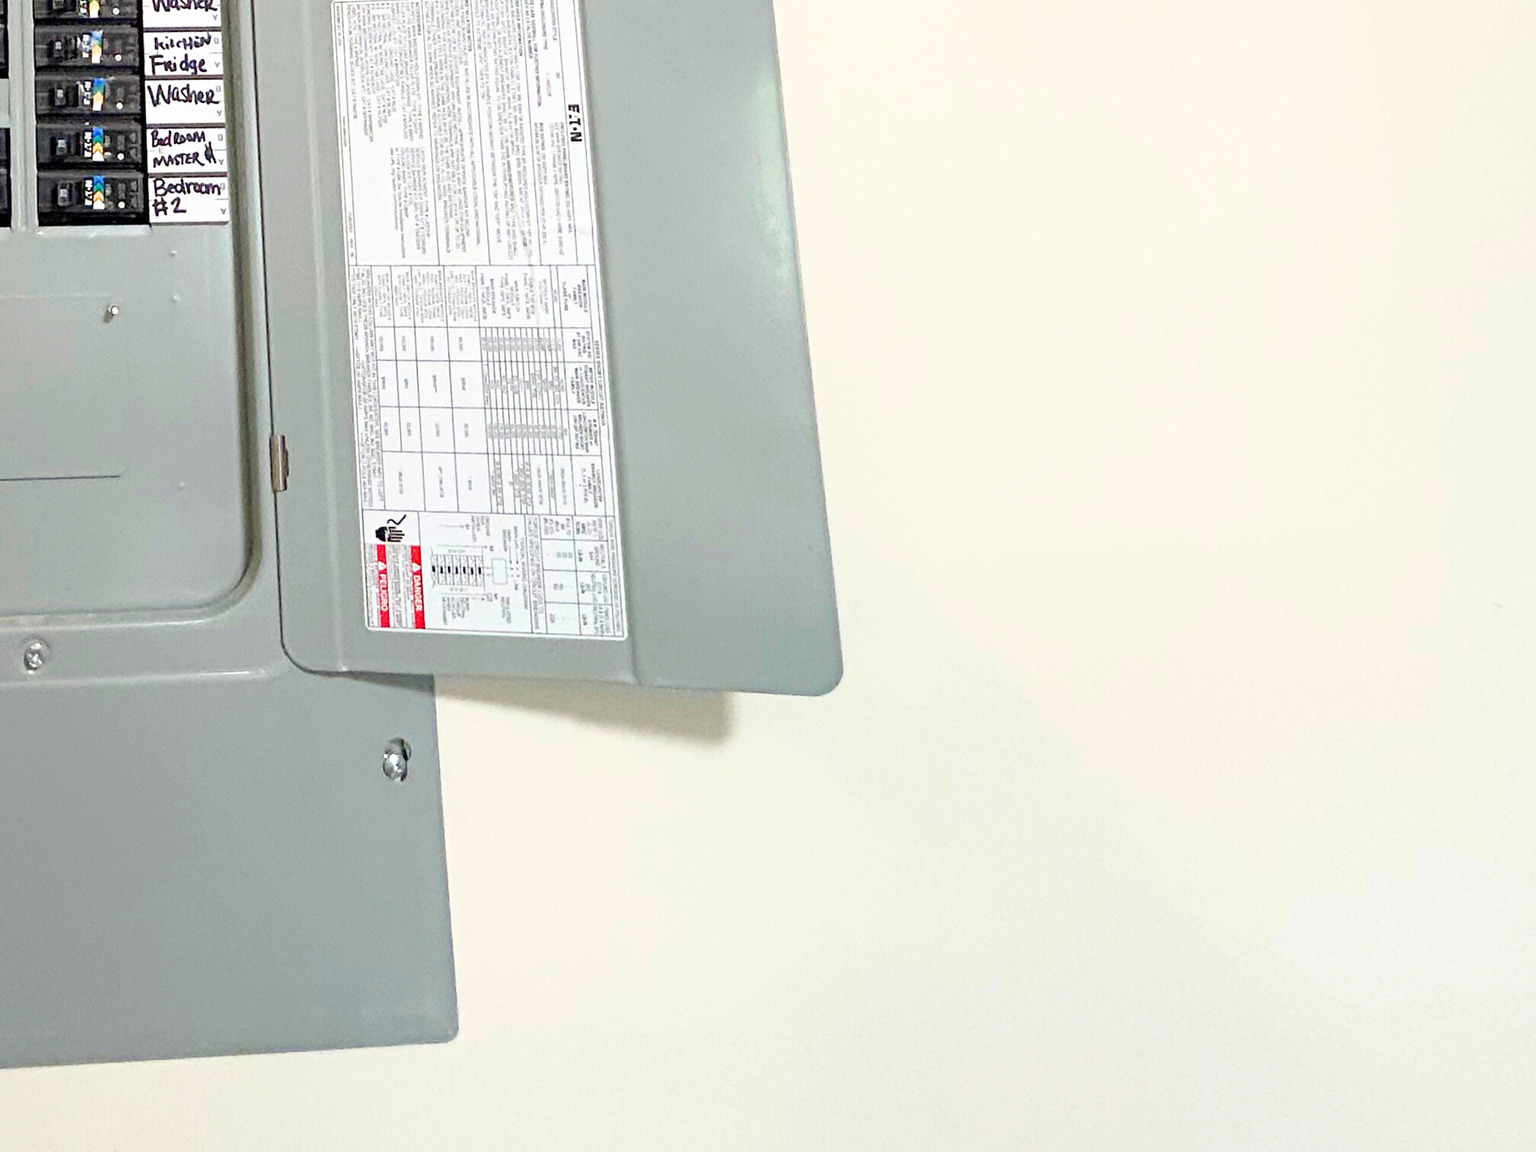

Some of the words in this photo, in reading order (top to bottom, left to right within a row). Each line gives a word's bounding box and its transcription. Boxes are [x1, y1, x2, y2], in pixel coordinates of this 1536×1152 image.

[153, 151, 205, 168] MASTER
[379, 574, 388, 612] PELIGRO
[414, 575, 423, 611] DANGER
